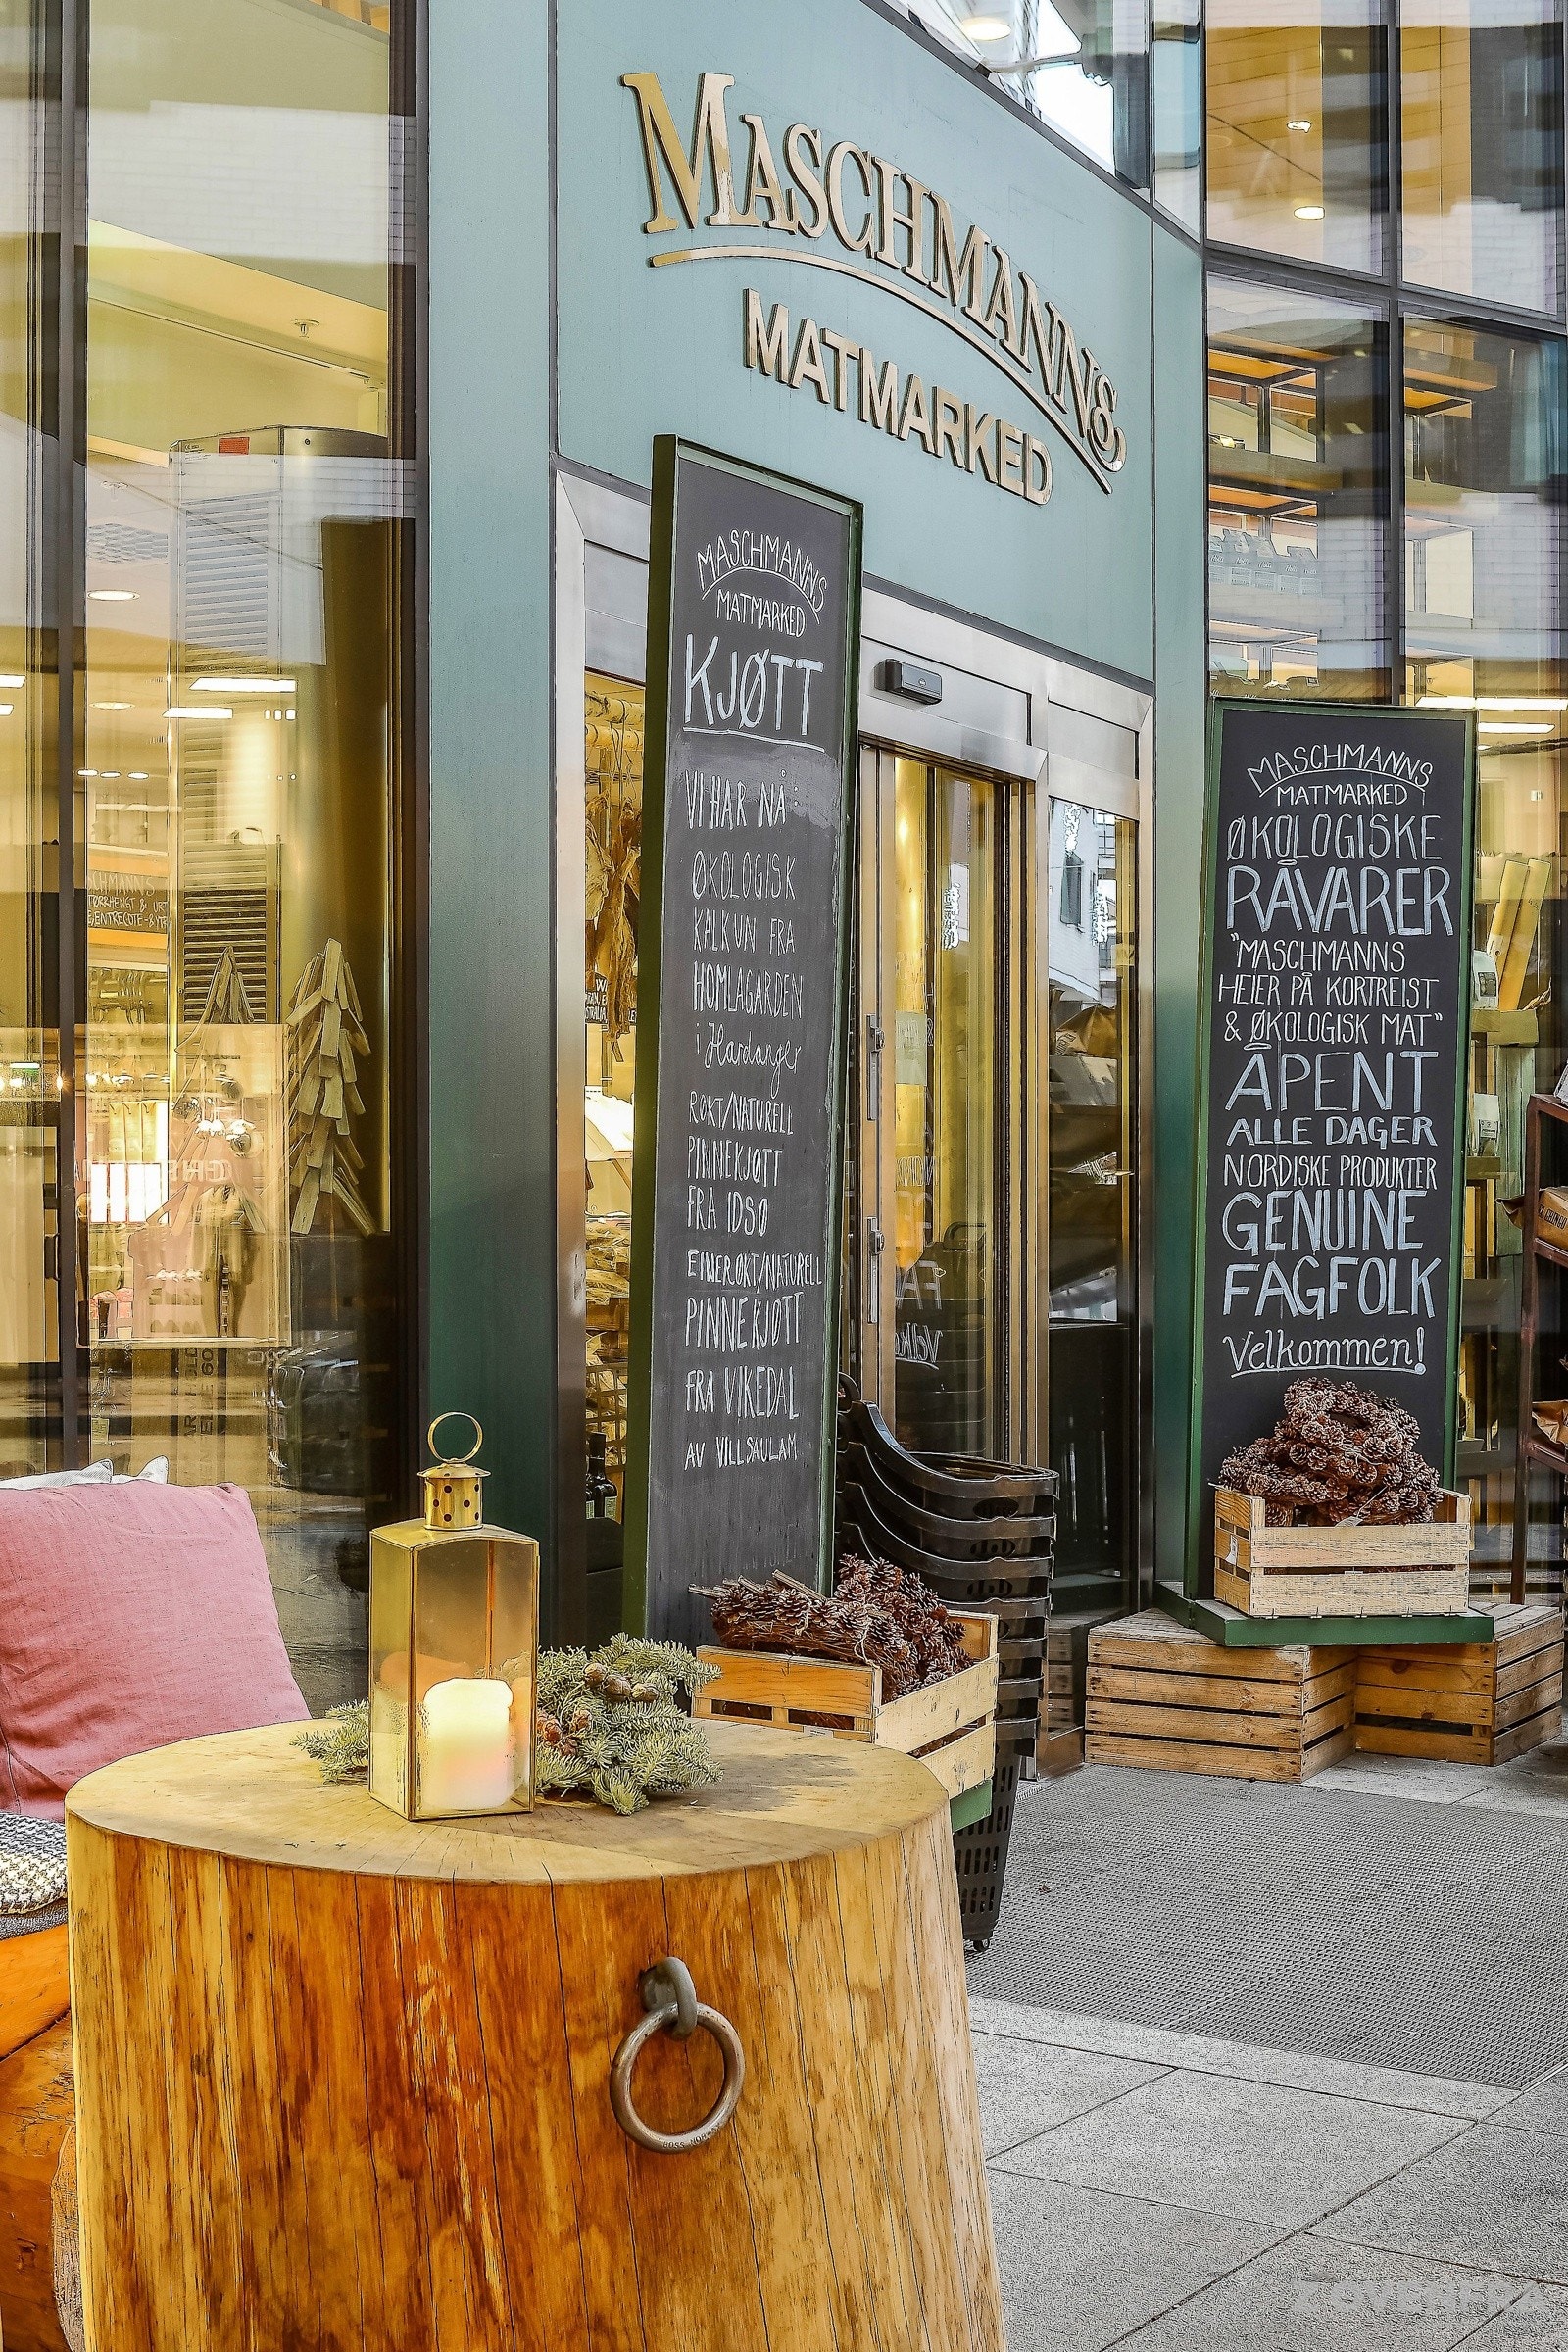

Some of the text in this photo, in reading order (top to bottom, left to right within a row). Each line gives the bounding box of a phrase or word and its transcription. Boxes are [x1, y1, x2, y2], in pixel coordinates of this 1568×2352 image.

[742, 287, 1054, 506] MATMARKED
[697, 529, 827, 612] MASCHMANNS
[715, 589, 806, 638] MATMARKED
[685, 633, 824, 735] KJØTT
[1247, 743, 1434, 794] MASCHMANNS
[685, 769, 704, 830] VI
[710, 775, 747, 830] HAR
[1277, 784, 1408, 807] MATMARKED
[1227, 813, 1442, 861] ØKOLOGISKE
[692, 850, 797, 900] ØKOLOGISK
[1227, 859, 1454, 936] RÅVARER
[693, 906, 796, 956] KALKUN FRA
[1218, 971, 1440, 1009] HEIER PÅ KORTREIST
[1224, 1010, 1242, 1042] &
[1250, 1009, 1370, 1046] ØKOLOGISK
[696, 1022, 802, 1099] i Hardanger
[1225, 1042, 1439, 1113] ÅPENT
[1226, 1117, 1312, 1147] ALLE
[1326, 1116, 1438, 1150] DAGER
[687, 1135, 783, 1188] PINNEKJØTT
[1224, 1154, 1438, 1190] NORDISKE PRODUKTER
[687, 1185, 769, 1238] FRA IDSØ
[1222, 1189, 1428, 1257] GENUINE
[1223, 1255, 1441, 1320] FAGFOLK
[685, 1291, 805, 1353] PINNEKJØTT
[1223, 1326, 1427, 1375] Velkommen!
[685, 1365, 800, 1420] FRA VIKEDAL
[684, 1442, 706, 1471] AV
